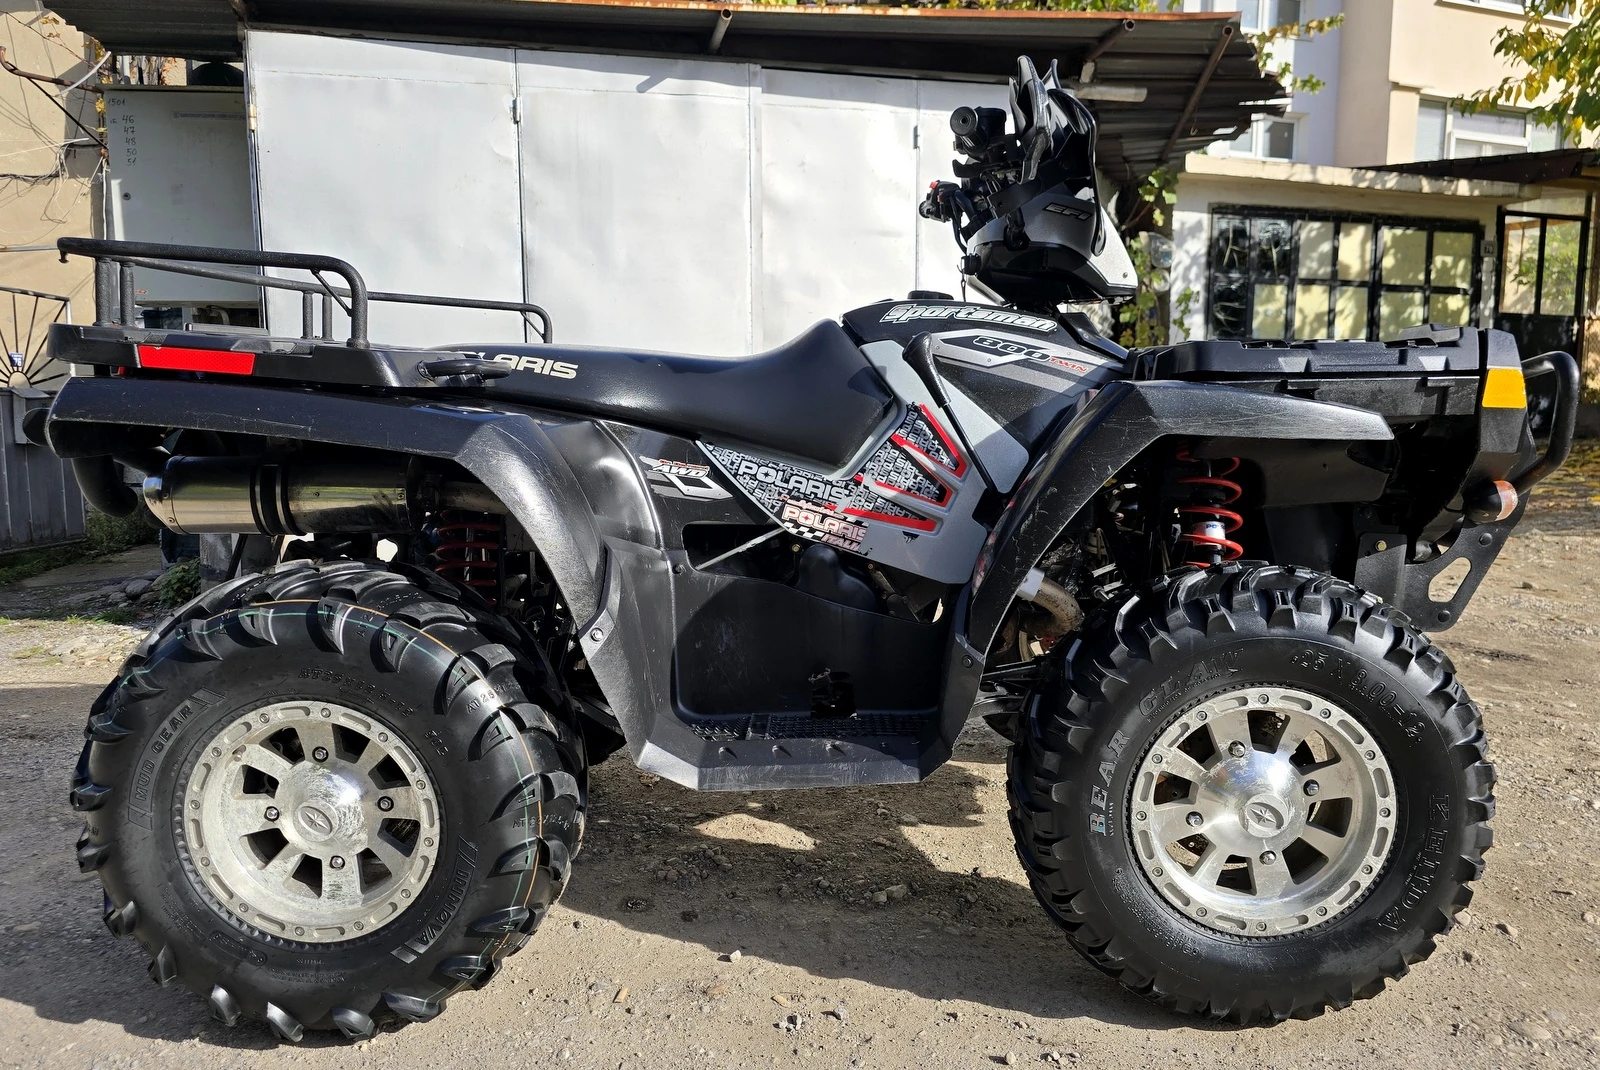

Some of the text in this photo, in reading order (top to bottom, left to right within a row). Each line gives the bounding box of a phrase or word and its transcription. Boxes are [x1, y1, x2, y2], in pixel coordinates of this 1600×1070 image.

[122, 115, 135, 124] 46
[124, 126, 135, 134] 47
[126, 137, 137, 146] 48
[126, 148, 137, 157] 50
[1042, 203, 1093, 220] EFI
[880, 303, 1058, 332] Sportsman
[972, 335, 1088, 373] 800 TWIN
[650, 464, 709, 479] AWD
[737, 459, 849, 501] POLARIS
[782, 503, 867, 542] POLARIS
[135, 760, 155, 801] MUD
[151, 705, 193, 755] GEAR
[1089, 648, 1244, 836] BEAR CLAW
[1378, 794, 1450, 931] KENDA
